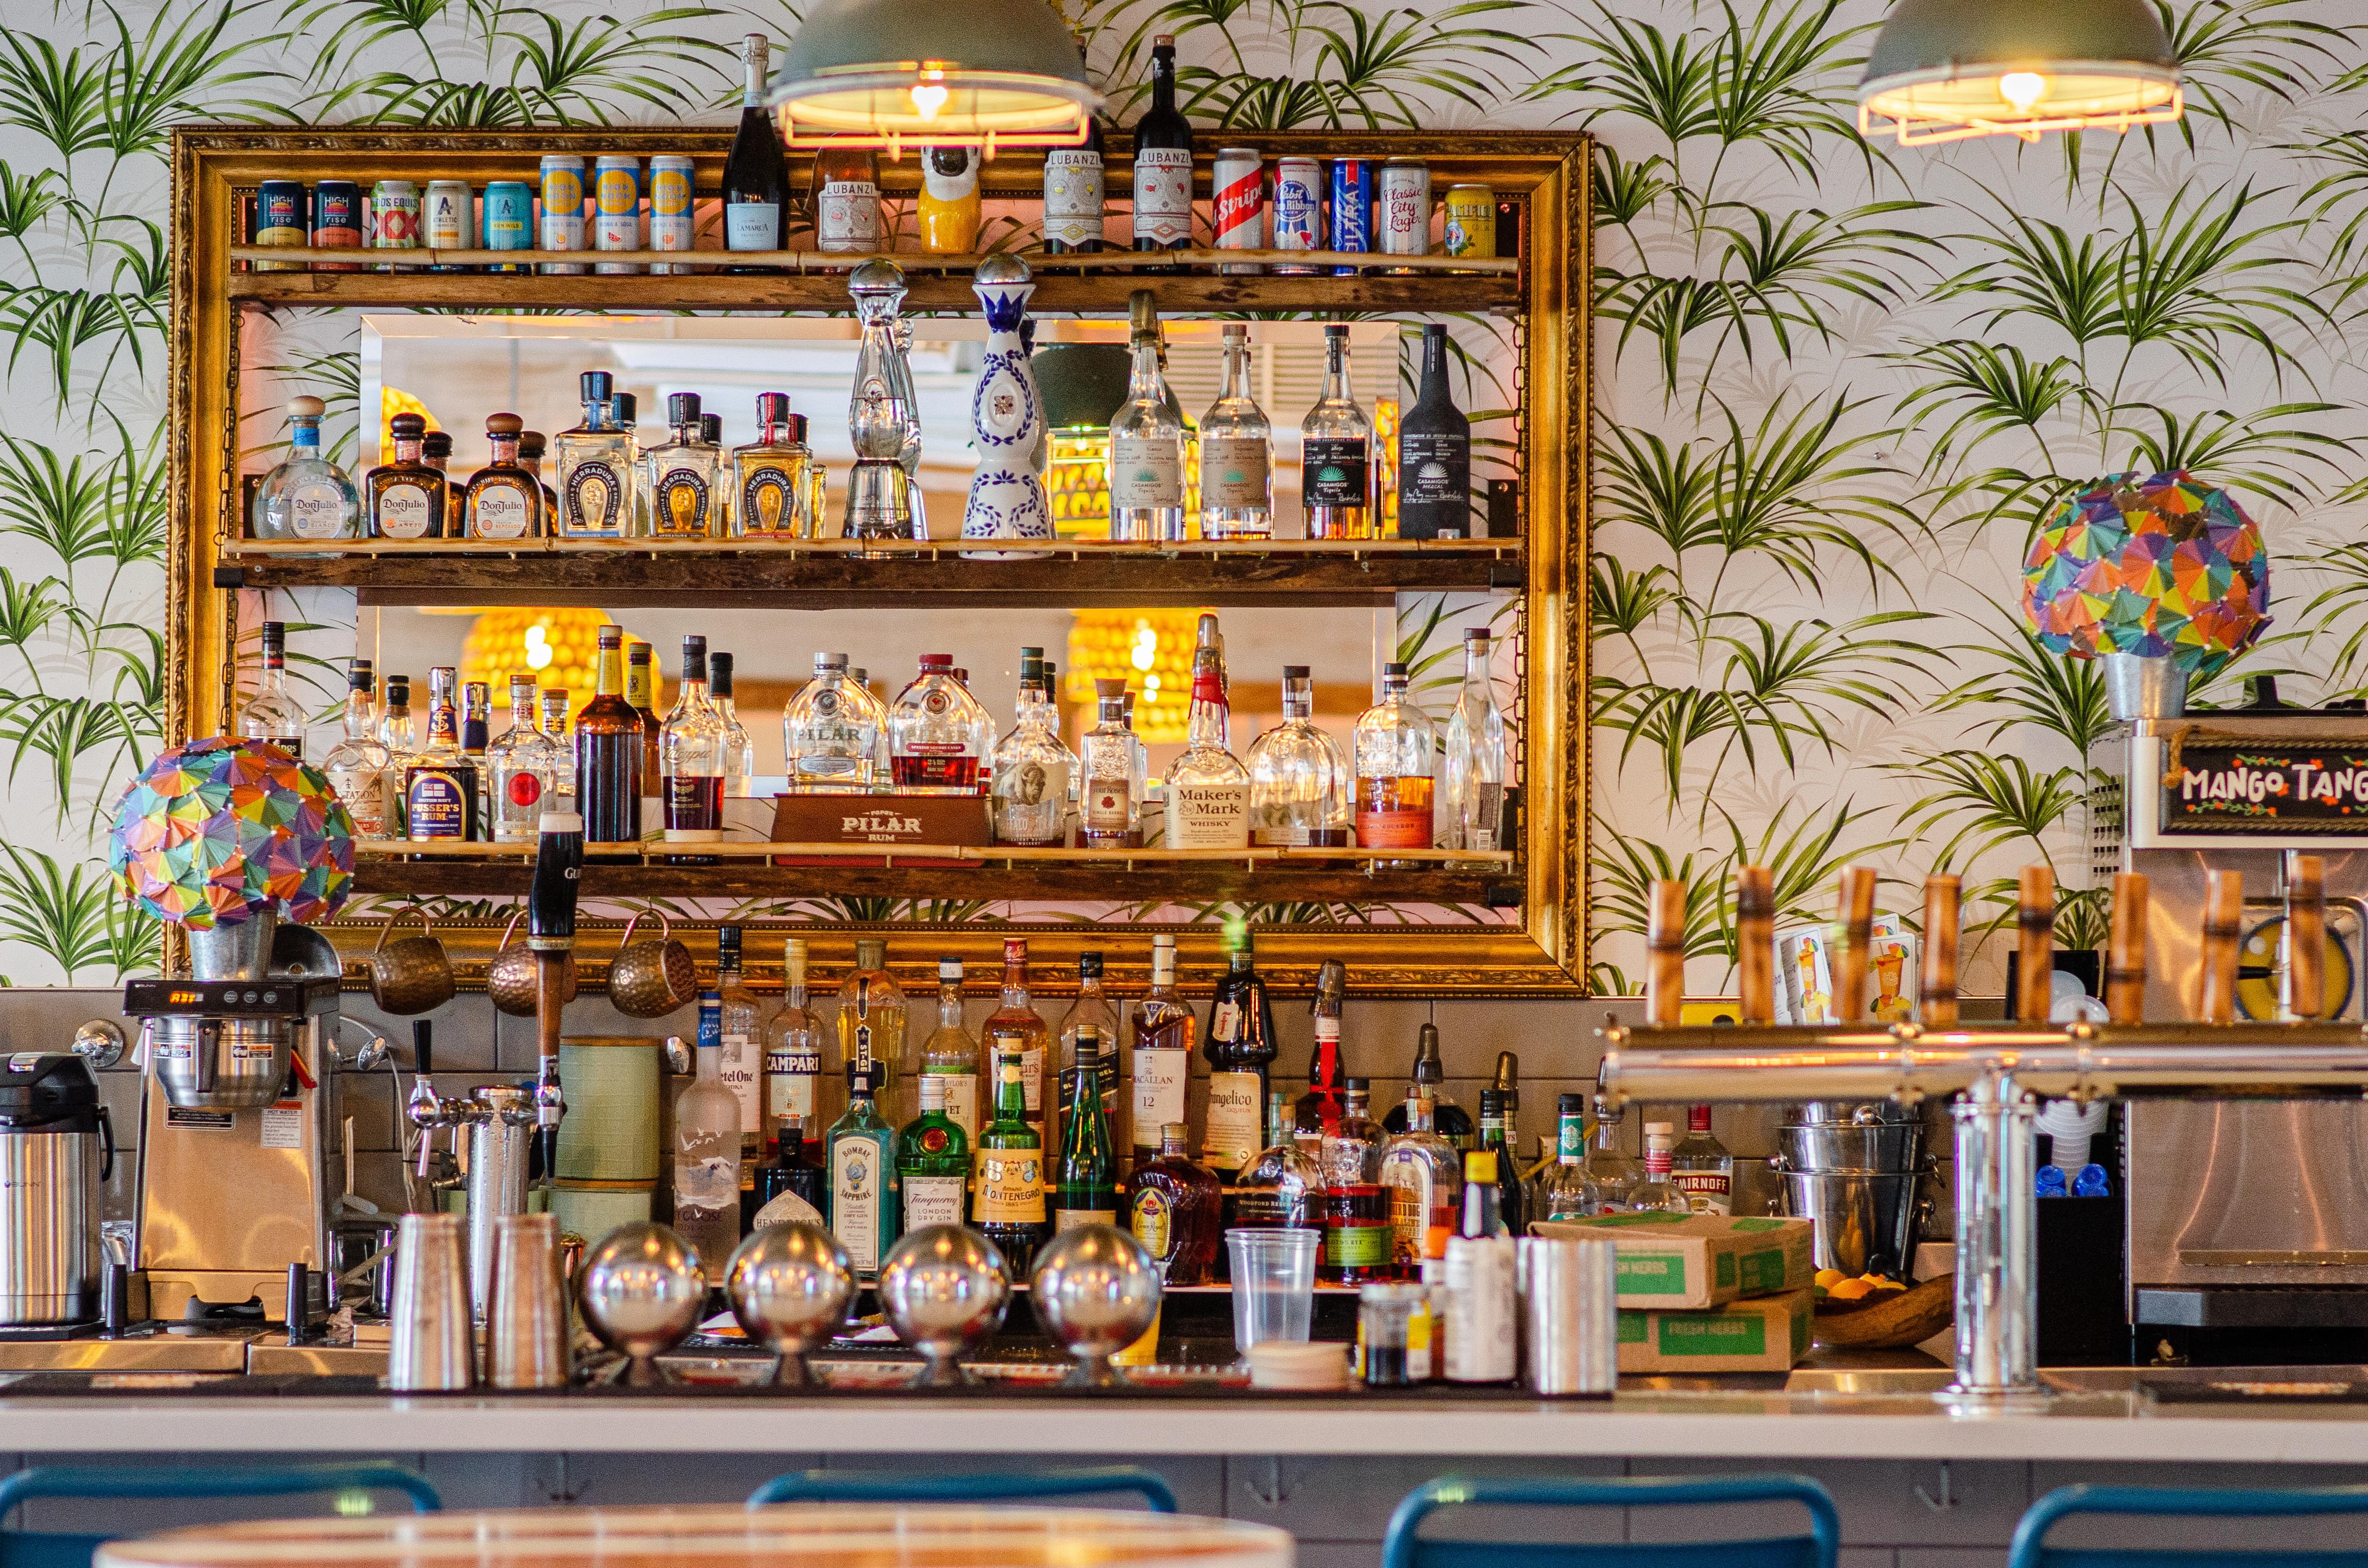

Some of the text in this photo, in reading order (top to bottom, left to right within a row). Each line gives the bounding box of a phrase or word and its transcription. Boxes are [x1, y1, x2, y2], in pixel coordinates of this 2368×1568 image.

[1051, 154, 1098, 165] LUBANZI
[1142, 152, 1189, 163] LUBANZI
[826, 184, 874, 194] LUBANZI
[1281, 183, 1304, 199] Pabst
[1383, 187, 1422, 202] Classic
[269, 196, 294, 208] HIGH
[324, 196, 349, 208] HIGH
[376, 197, 417, 208] DOS EQUIS
[1218, 183, 1263, 221] Stripe
[1286, 199, 1315, 211] Ribbon
[1391, 200, 1419, 217] City
[1386, 215, 1421, 233] Lager
[571, 467, 617, 487] HERRADURA
[661, 474, 703, 492] HERRADURA
[748, 474, 790, 492] HERRADURA
[795, 724, 861, 741] PILAR
[663, 746, 712, 764] Zacapa
[1108, 785, 1126, 794] Roses
[2182, 766, 2286, 803] MANGO
[1178, 789, 1242, 800] Maker's
[412, 804, 459, 812] PUSSER'S
[1196, 803, 1242, 814] Mark
[421, 812, 446, 821] RUM
[841, 817, 922, 833] PILAR
[766, 1056, 819, 1071] CAMPARI
[736, 1070, 753, 1082] One
[1143, 1096, 1155, 1107] 12
[842, 1146, 871, 1158] BOMBAY
[840, 1188, 873, 1201] SAPPHIRE
[982, 1184, 1040, 1201] MONTENEGRO
[911, 1193, 958, 1206] Tanqueray
[1408, 1204, 1420, 1217] DOG
